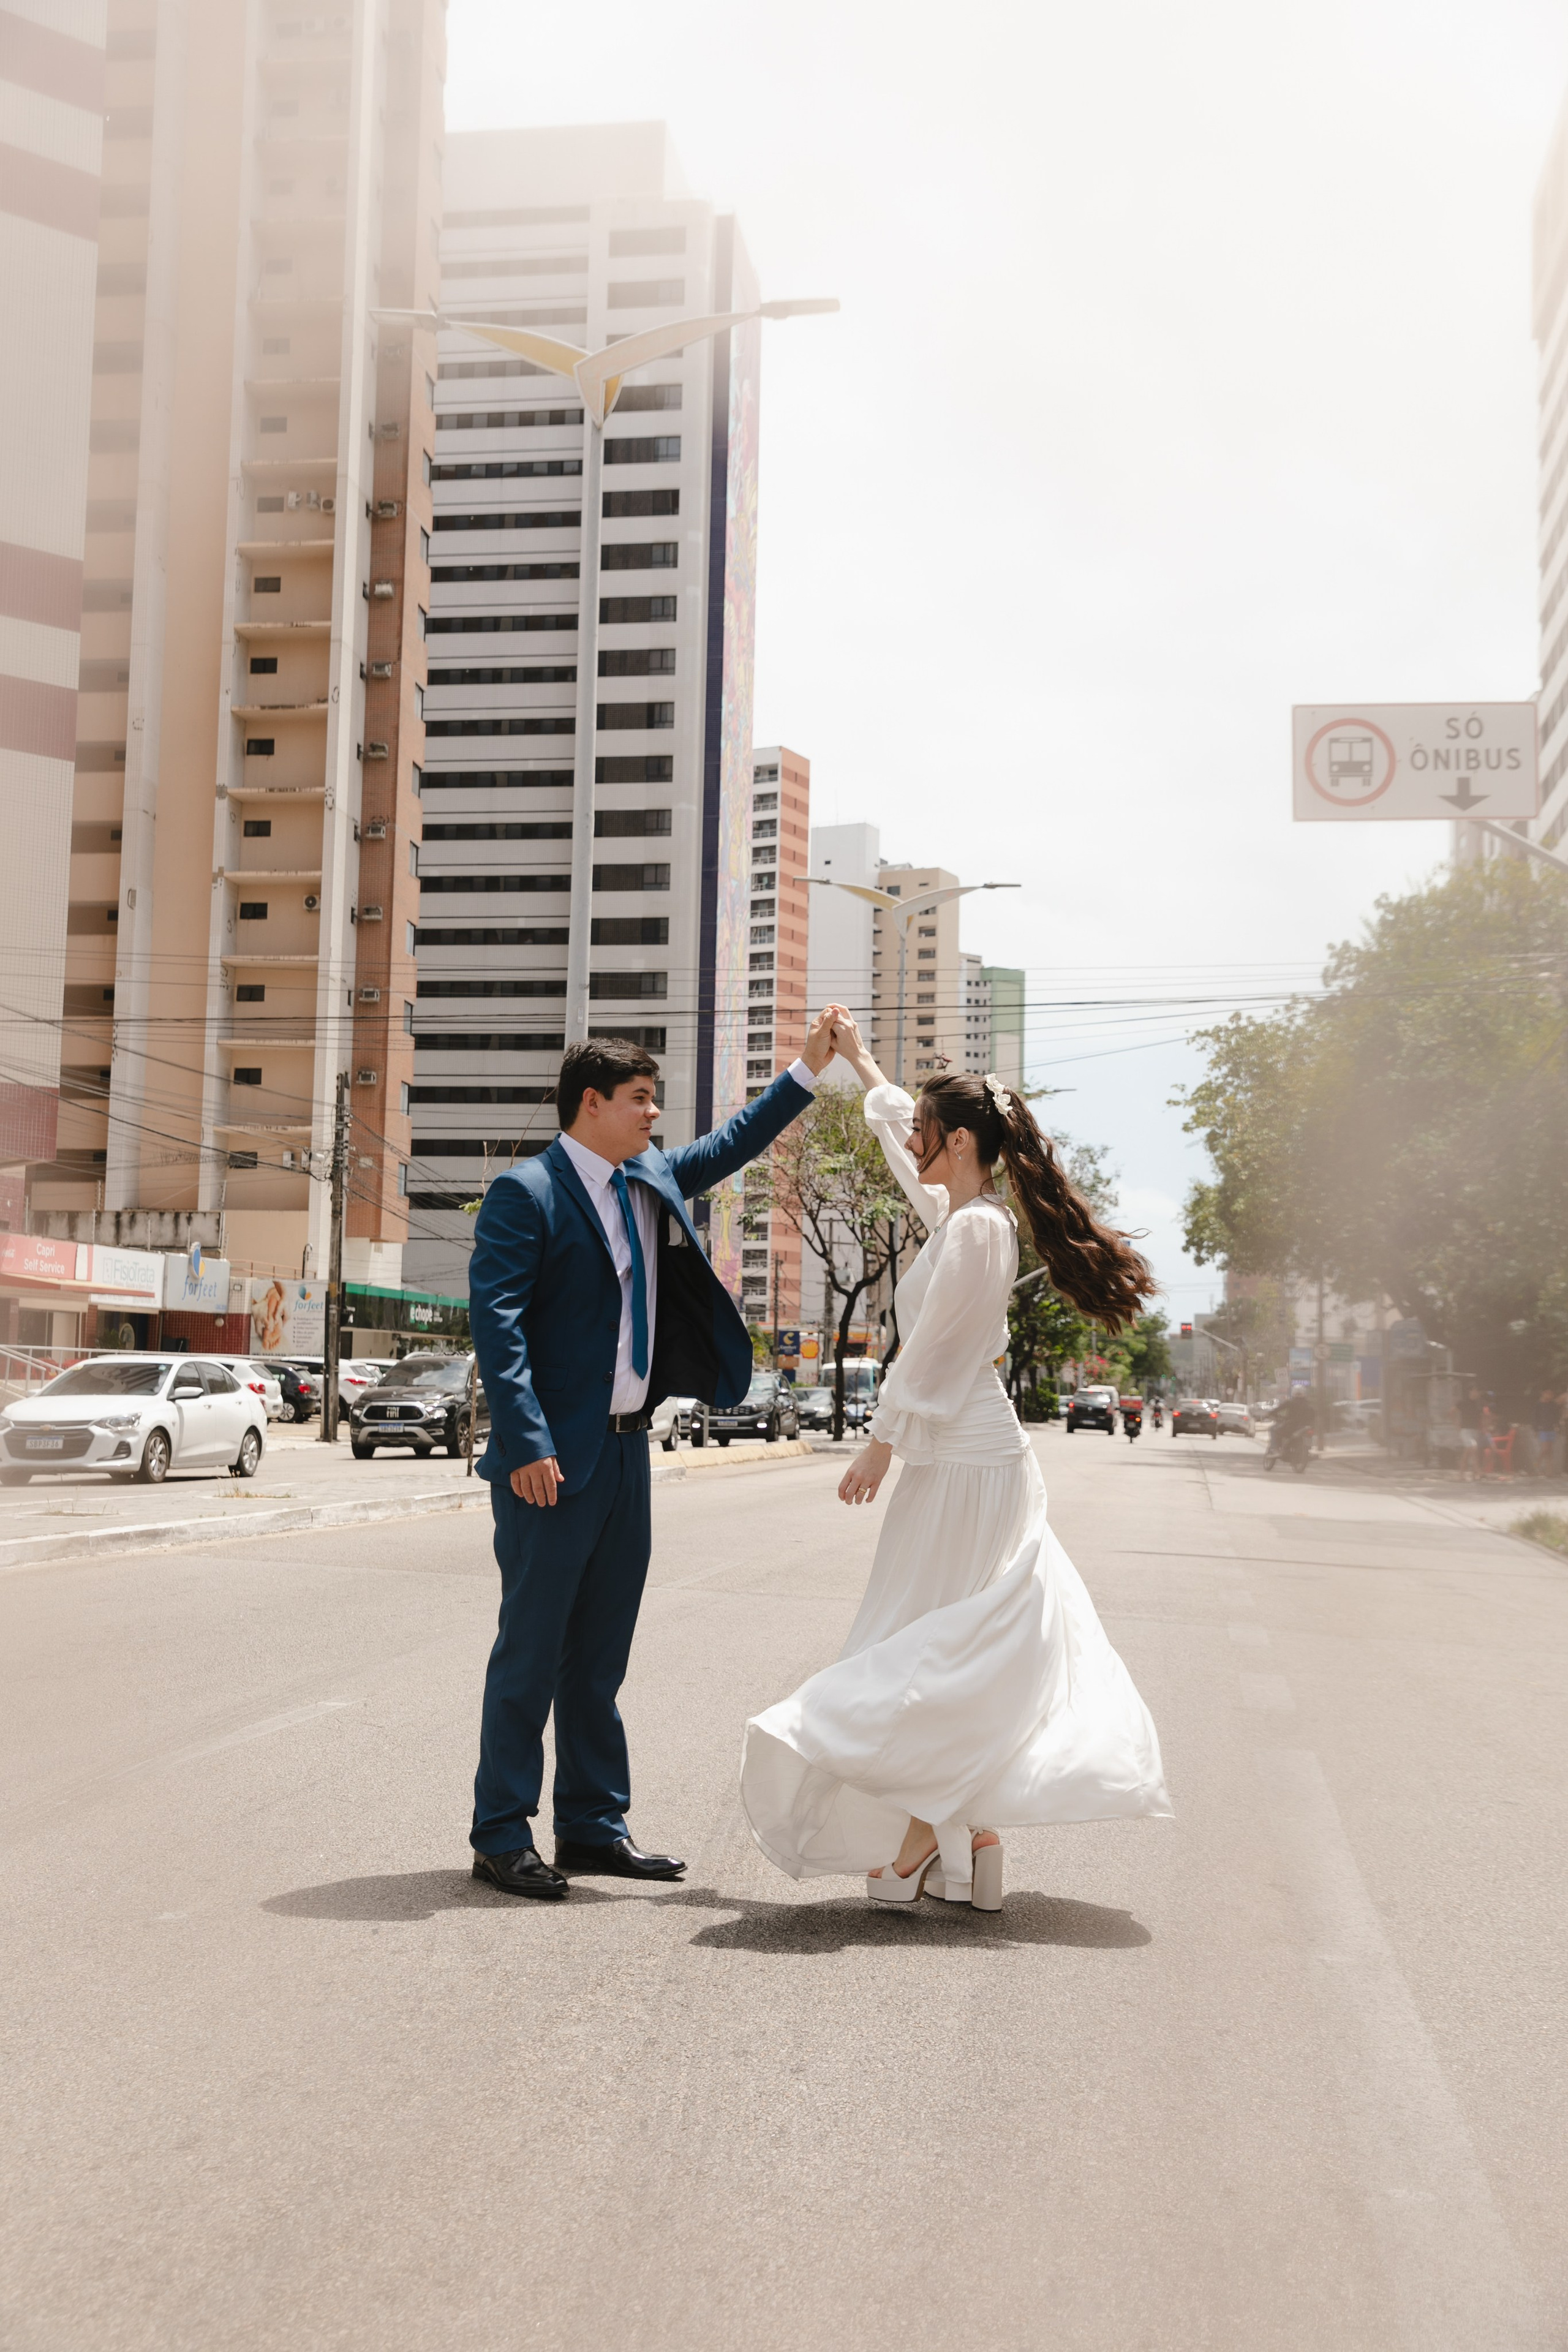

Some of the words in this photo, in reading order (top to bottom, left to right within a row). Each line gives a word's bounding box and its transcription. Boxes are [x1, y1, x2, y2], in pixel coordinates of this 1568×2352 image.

[1446, 710, 1484, 740] SÓ
[1410, 743, 1521, 771] ÔNIBUS
[37, 1243, 56, 1258] Capri
[24, 1258, 39, 1271] Self
[39, 1259, 65, 1275] Service
[113, 1259, 155, 1283] FisioTrata
[386, 1406, 400, 1418] FIAT
